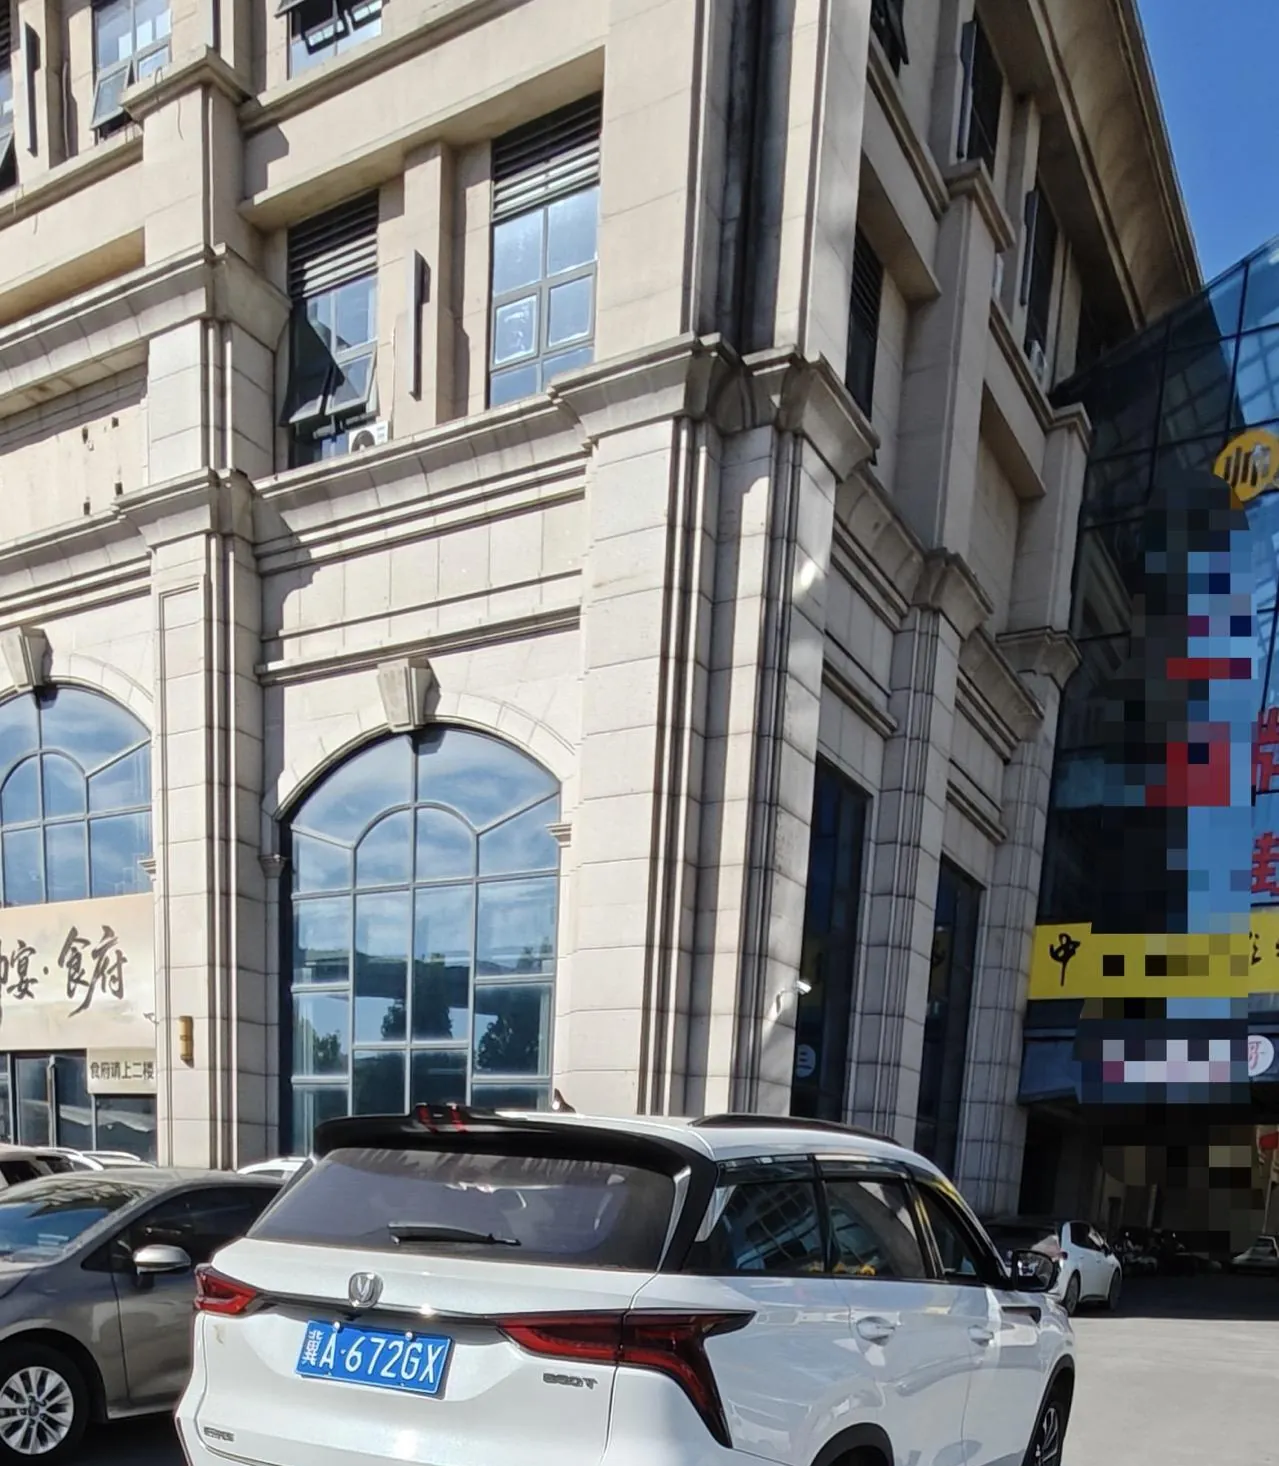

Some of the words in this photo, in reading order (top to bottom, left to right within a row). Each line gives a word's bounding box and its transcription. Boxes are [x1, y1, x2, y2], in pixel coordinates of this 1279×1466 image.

[0, 925, 128, 1018] 宴·食府
[90, 1061, 155, 1080] 食府请上二楼
